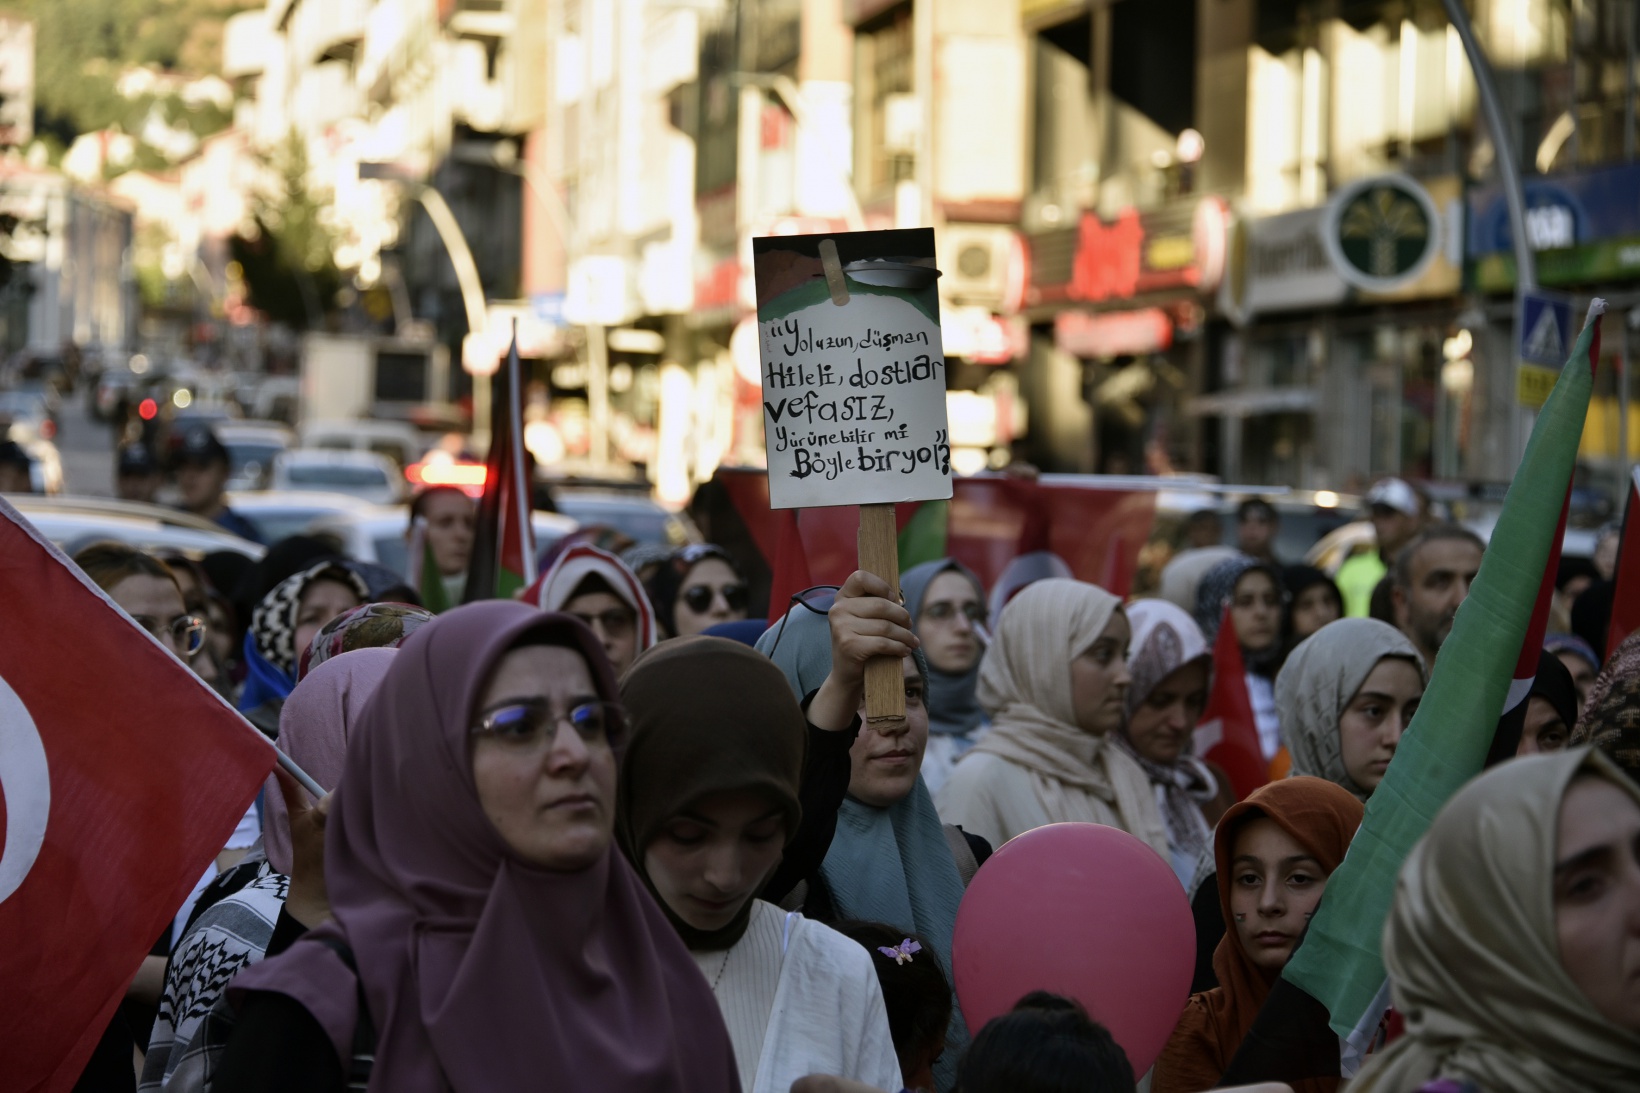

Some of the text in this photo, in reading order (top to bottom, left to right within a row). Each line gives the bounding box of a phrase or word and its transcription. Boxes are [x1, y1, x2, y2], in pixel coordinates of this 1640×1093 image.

[859, 328, 929, 351] düşman
[765, 354, 943, 389] Hileli, dostlar
[884, 423, 910, 440] mi
[789, 448, 856, 480] Böyle
